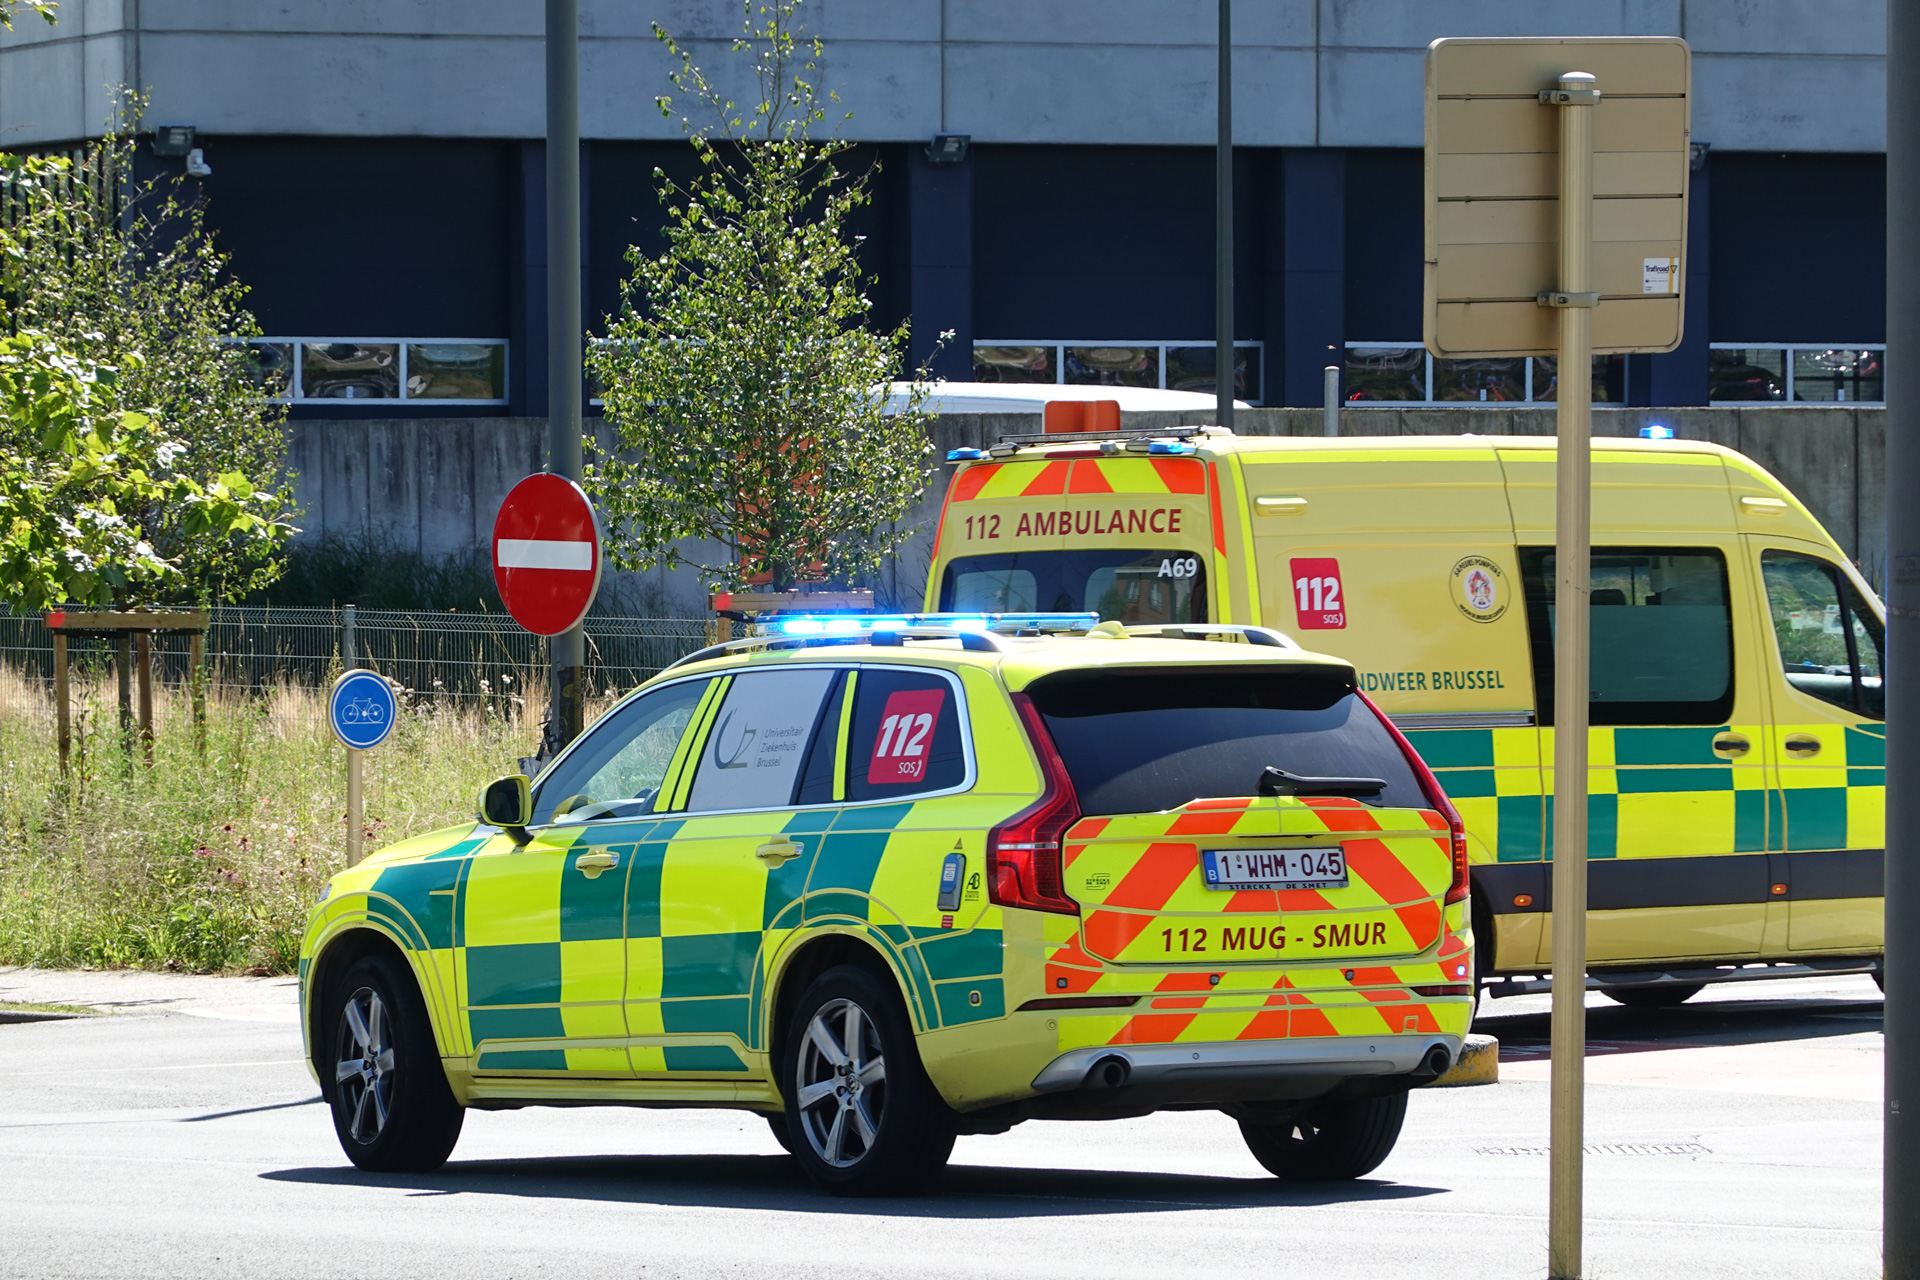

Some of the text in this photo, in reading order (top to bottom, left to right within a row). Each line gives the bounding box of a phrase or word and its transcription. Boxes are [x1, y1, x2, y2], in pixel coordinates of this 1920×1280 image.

[965, 508, 1182, 540] 112 AMBULANCE
[1157, 558, 1198, 578] A69
[1295, 576, 1340, 611] 112
[1432, 670, 1505, 690] BRUSSEL
[764, 726, 804, 738] Universitair
[876, 713, 933, 757] 112
[760, 741, 797, 753] Ziekenhuis
[756, 756, 781, 768] Brussel
[1208, 869, 1218, 880] B
[1161, 928, 1208, 952] 112
[1222, 926, 1286, 951] MUG
[1313, 922, 1387, 948] SMUR
